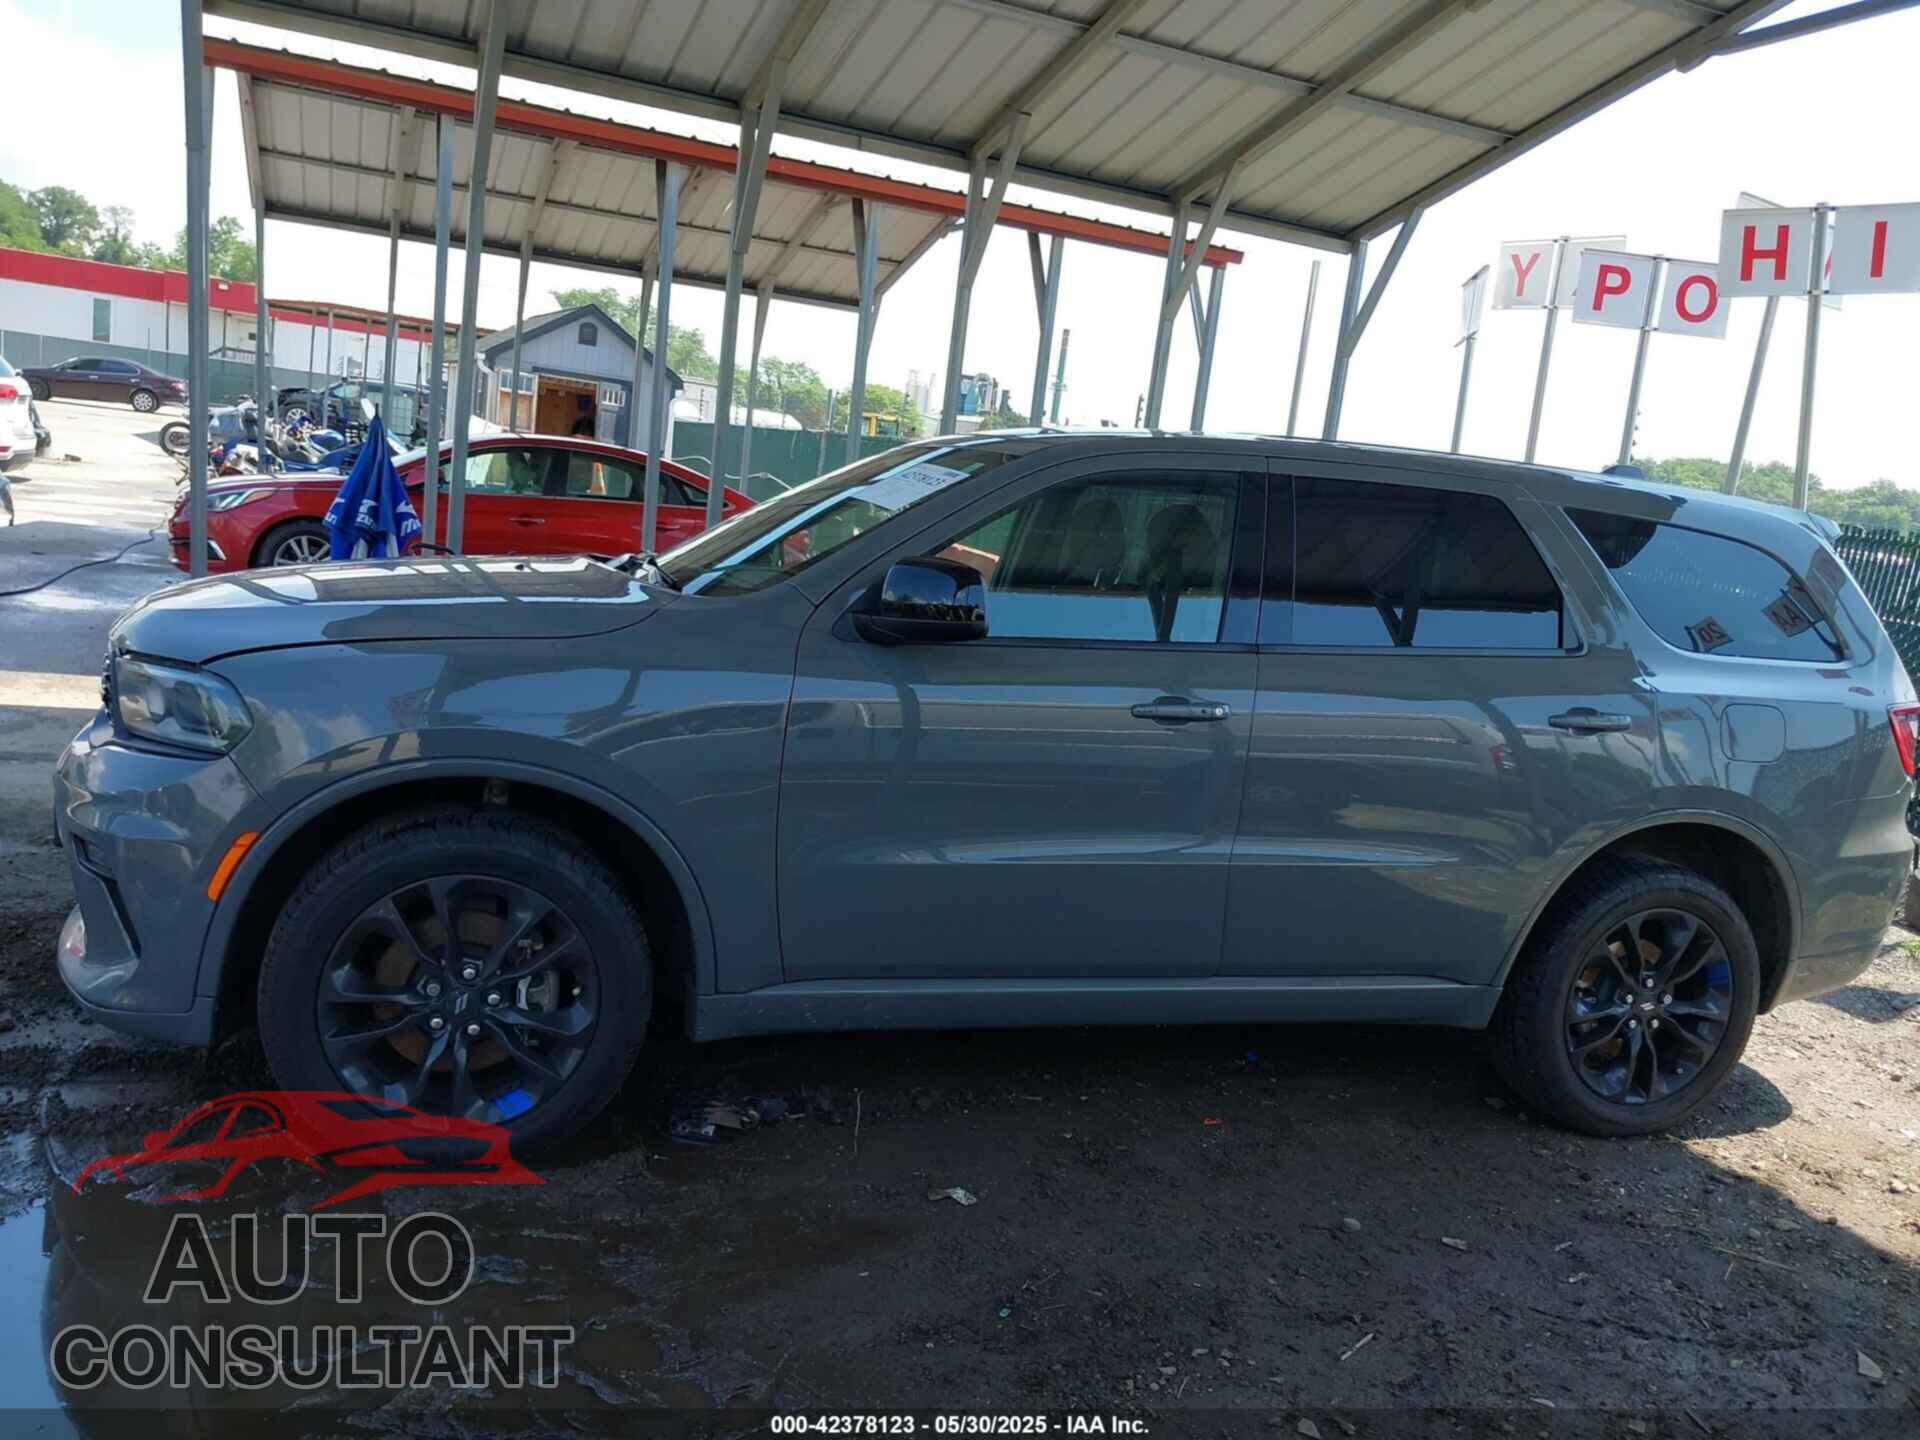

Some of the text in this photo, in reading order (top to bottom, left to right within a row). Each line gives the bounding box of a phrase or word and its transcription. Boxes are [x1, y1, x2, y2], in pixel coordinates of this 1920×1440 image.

[1740, 224, 1790, 281] H
[1870, 221, 1888, 278] I
[1511, 253, 1541, 296] Y
[1592, 264, 1632, 311] P
[1674, 275, 1719, 323] O
